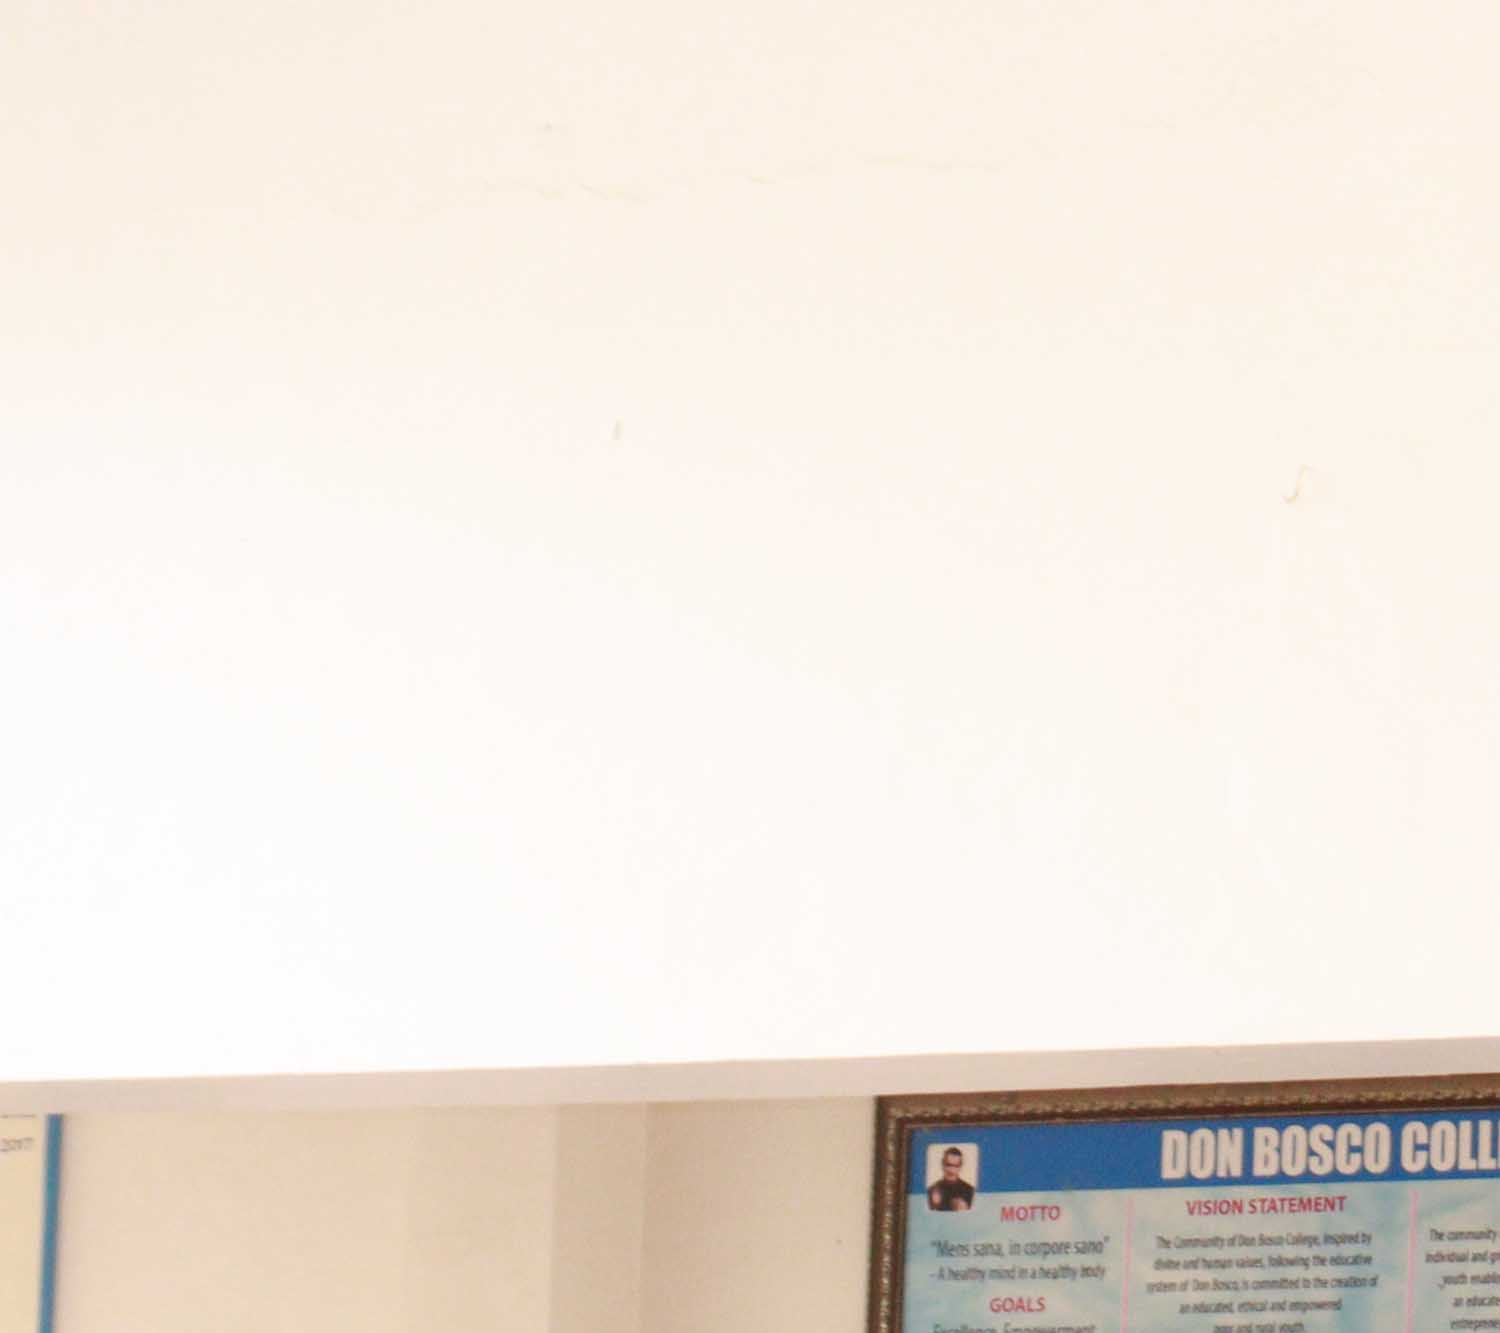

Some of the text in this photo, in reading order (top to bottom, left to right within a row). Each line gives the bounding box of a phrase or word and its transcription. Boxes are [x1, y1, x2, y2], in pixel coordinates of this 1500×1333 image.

[1162, 1129, 1242, 1179] DON
[1253, 1122, 1390, 1177] BOSCO
[1000, 1206, 1060, 1222] MOTTO
[1186, 1196, 1347, 1216] VISION STATEMENT
[990, 1297, 1045, 1313] GOALS
